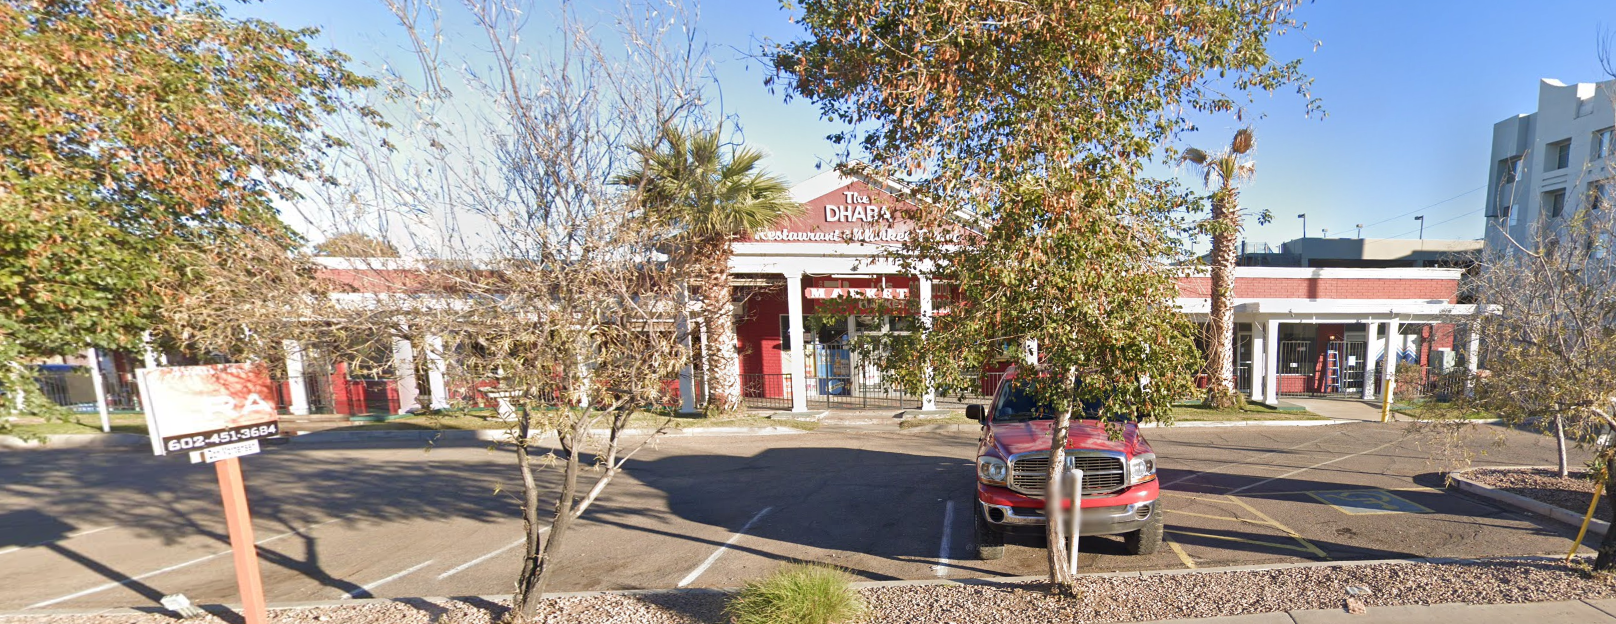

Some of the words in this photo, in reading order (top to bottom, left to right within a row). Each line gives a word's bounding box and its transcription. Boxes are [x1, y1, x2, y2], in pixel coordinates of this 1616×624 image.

[843, 191, 870, 204] The
[825, 204, 892, 222] DHABA
[754, 227, 842, 242] Restaurant
[811, 288, 908, 299] MARKET
[167, 424, 277, 451] 602-451-3684
